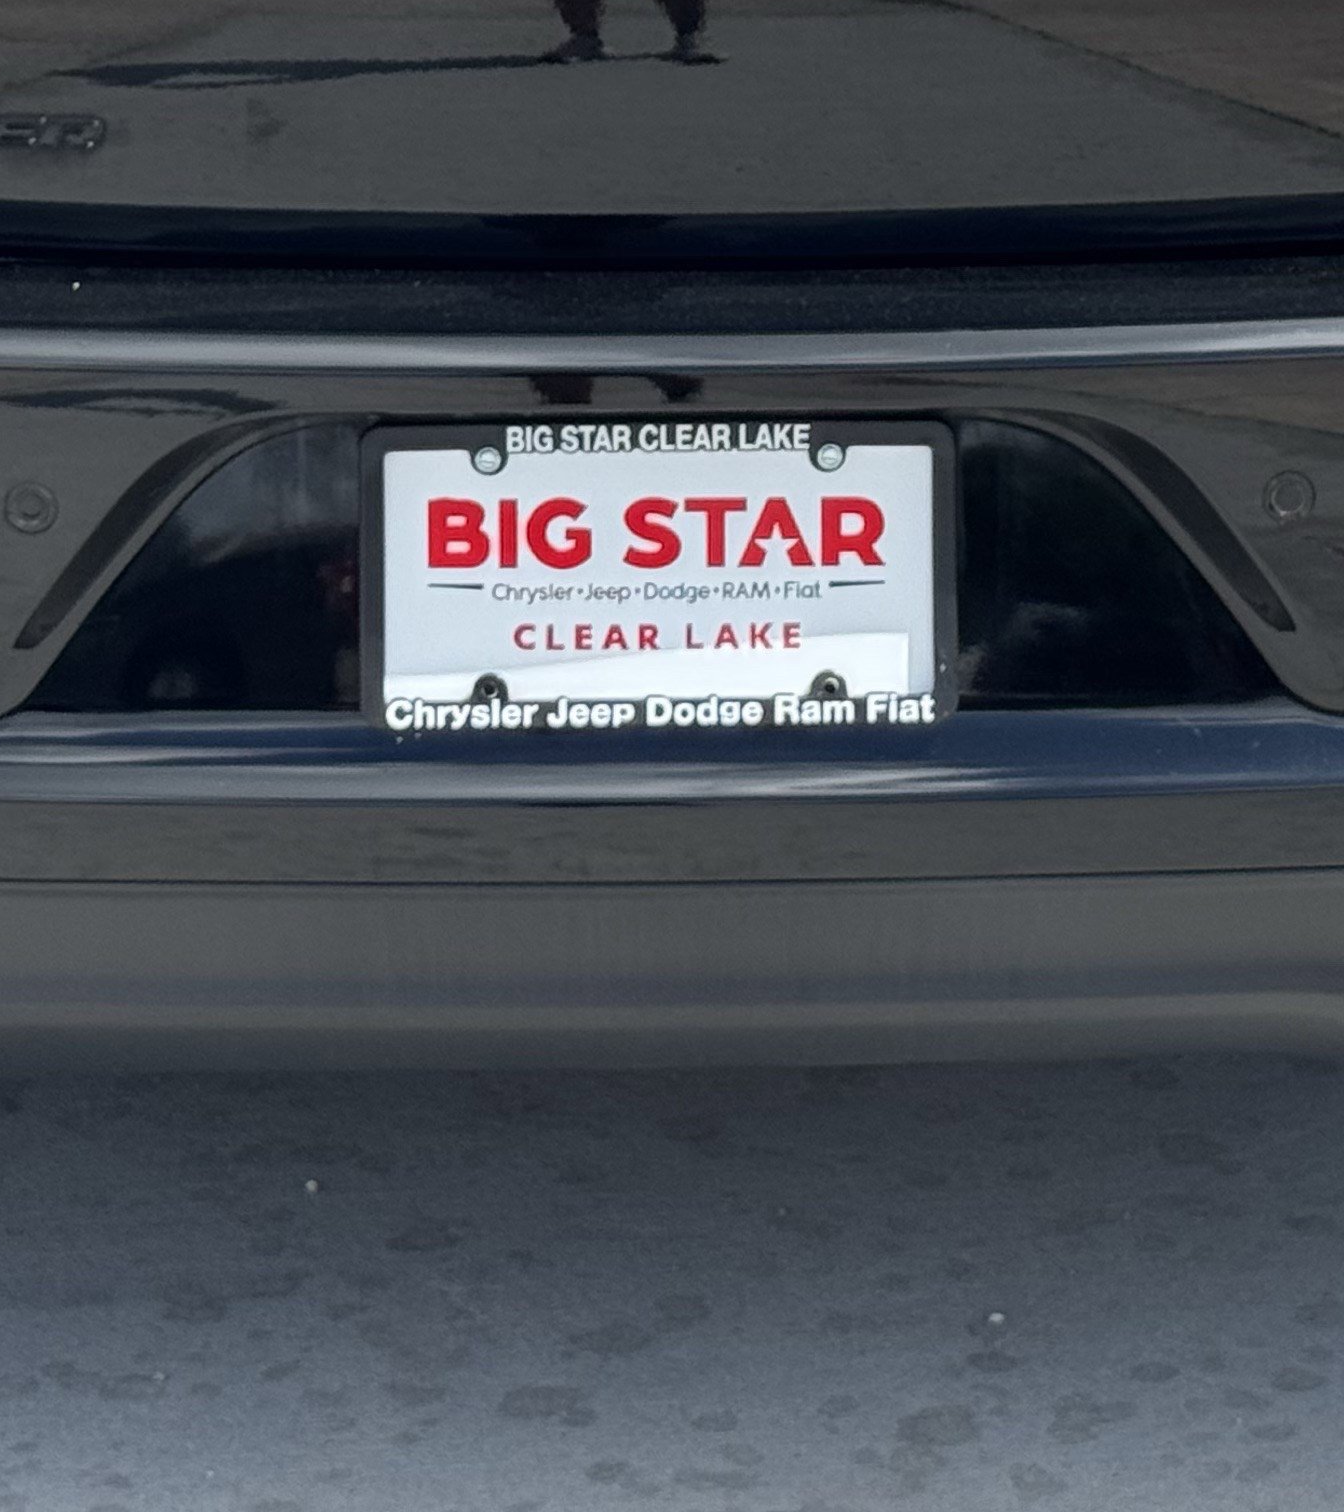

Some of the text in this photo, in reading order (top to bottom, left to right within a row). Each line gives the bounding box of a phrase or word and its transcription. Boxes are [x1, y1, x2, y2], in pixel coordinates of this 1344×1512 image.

[506, 424, 810, 453] BIG STAR CLEAR LAKE
[427, 497, 885, 569] BIG STAR
[491, 581, 572, 605] Chrysler
[584, 583, 632, 605] Jeep
[642, 582, 711, 603] Dodge
[721, 582, 772, 600] RAM
[513, 622, 802, 651] CLEAR LAKE
[386, 692, 936, 731] Chrysler Jeep Dodge Ram Fiat
